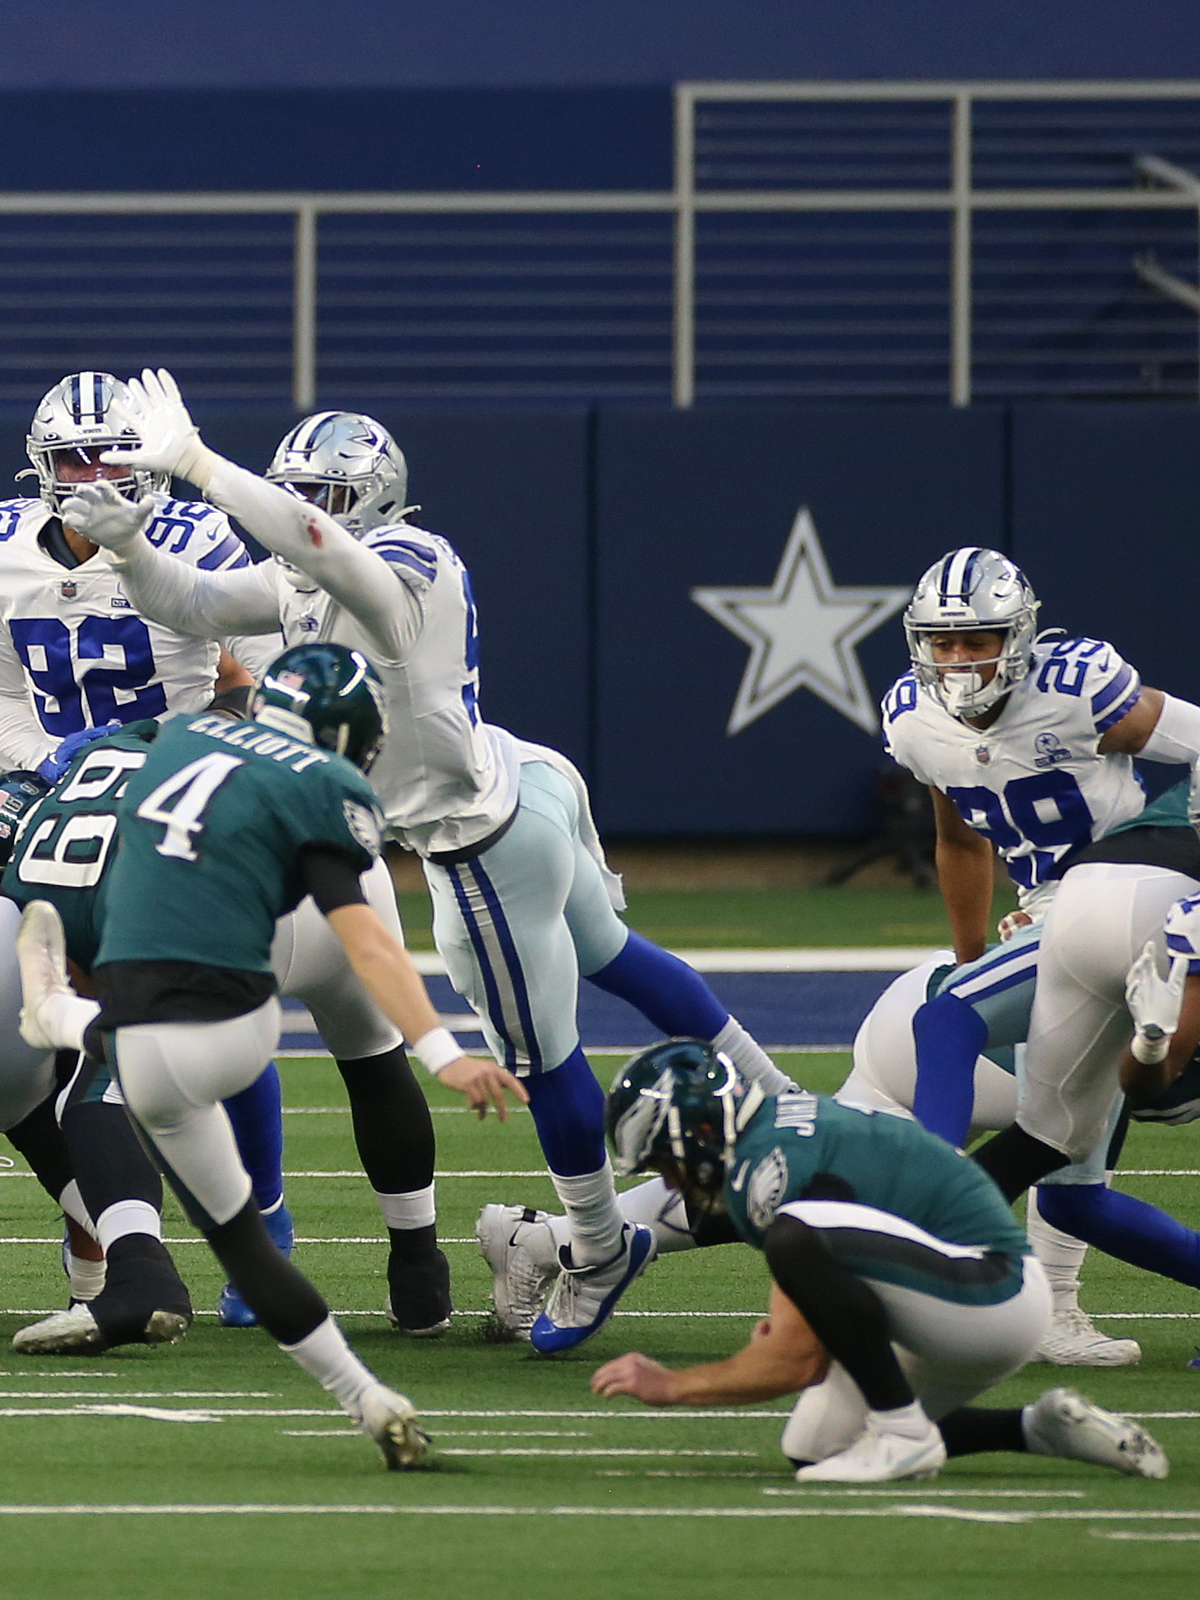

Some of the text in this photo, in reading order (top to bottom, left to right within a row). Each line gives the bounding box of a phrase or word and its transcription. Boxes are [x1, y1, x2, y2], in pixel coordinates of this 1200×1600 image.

[9, 617, 169, 738] 92
[1037, 638, 1104, 697] 29
[186, 715, 331, 774] ELLIOTT
[18, 749, 148, 888] 69
[136, 750, 246, 862] 4
[946, 768, 1095, 889] 29
